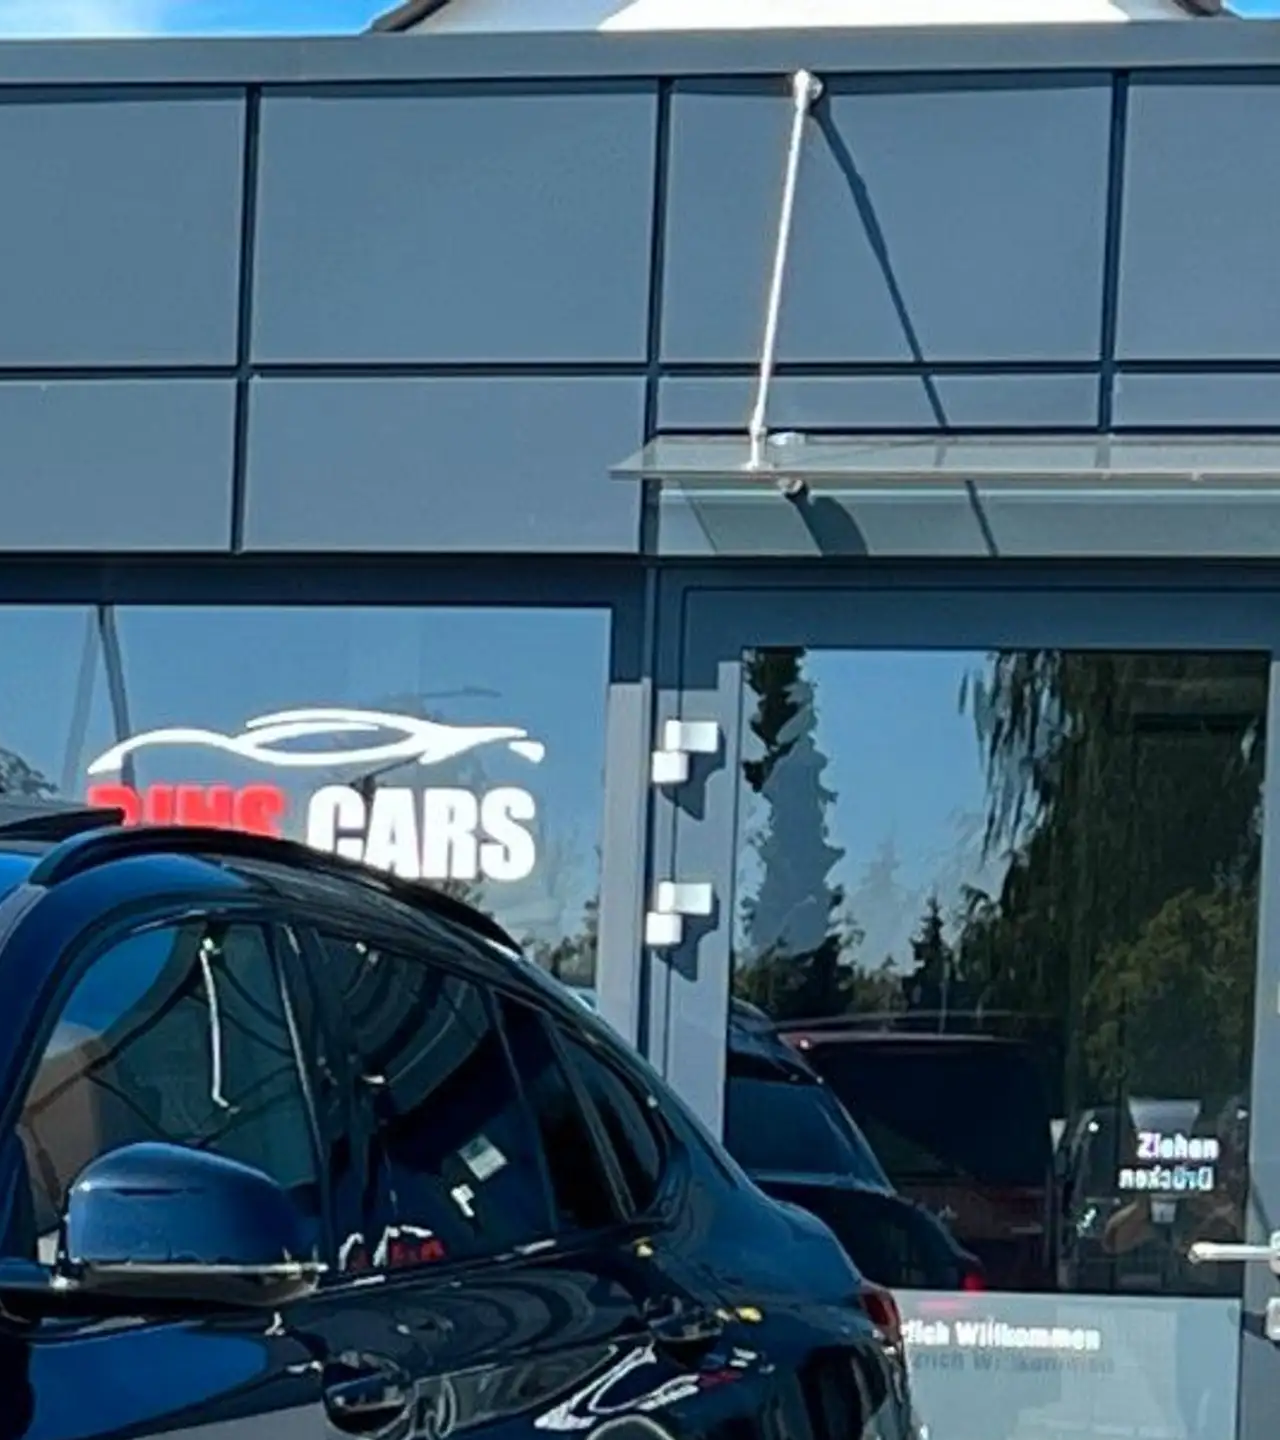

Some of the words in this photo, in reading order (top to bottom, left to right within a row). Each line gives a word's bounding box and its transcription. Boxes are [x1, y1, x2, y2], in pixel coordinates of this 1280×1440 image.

[307, 784, 537, 881] CARS
[1137, 1131, 1219, 1159] Ziehen
[954, 1318, 1100, 1350] Willkommen
